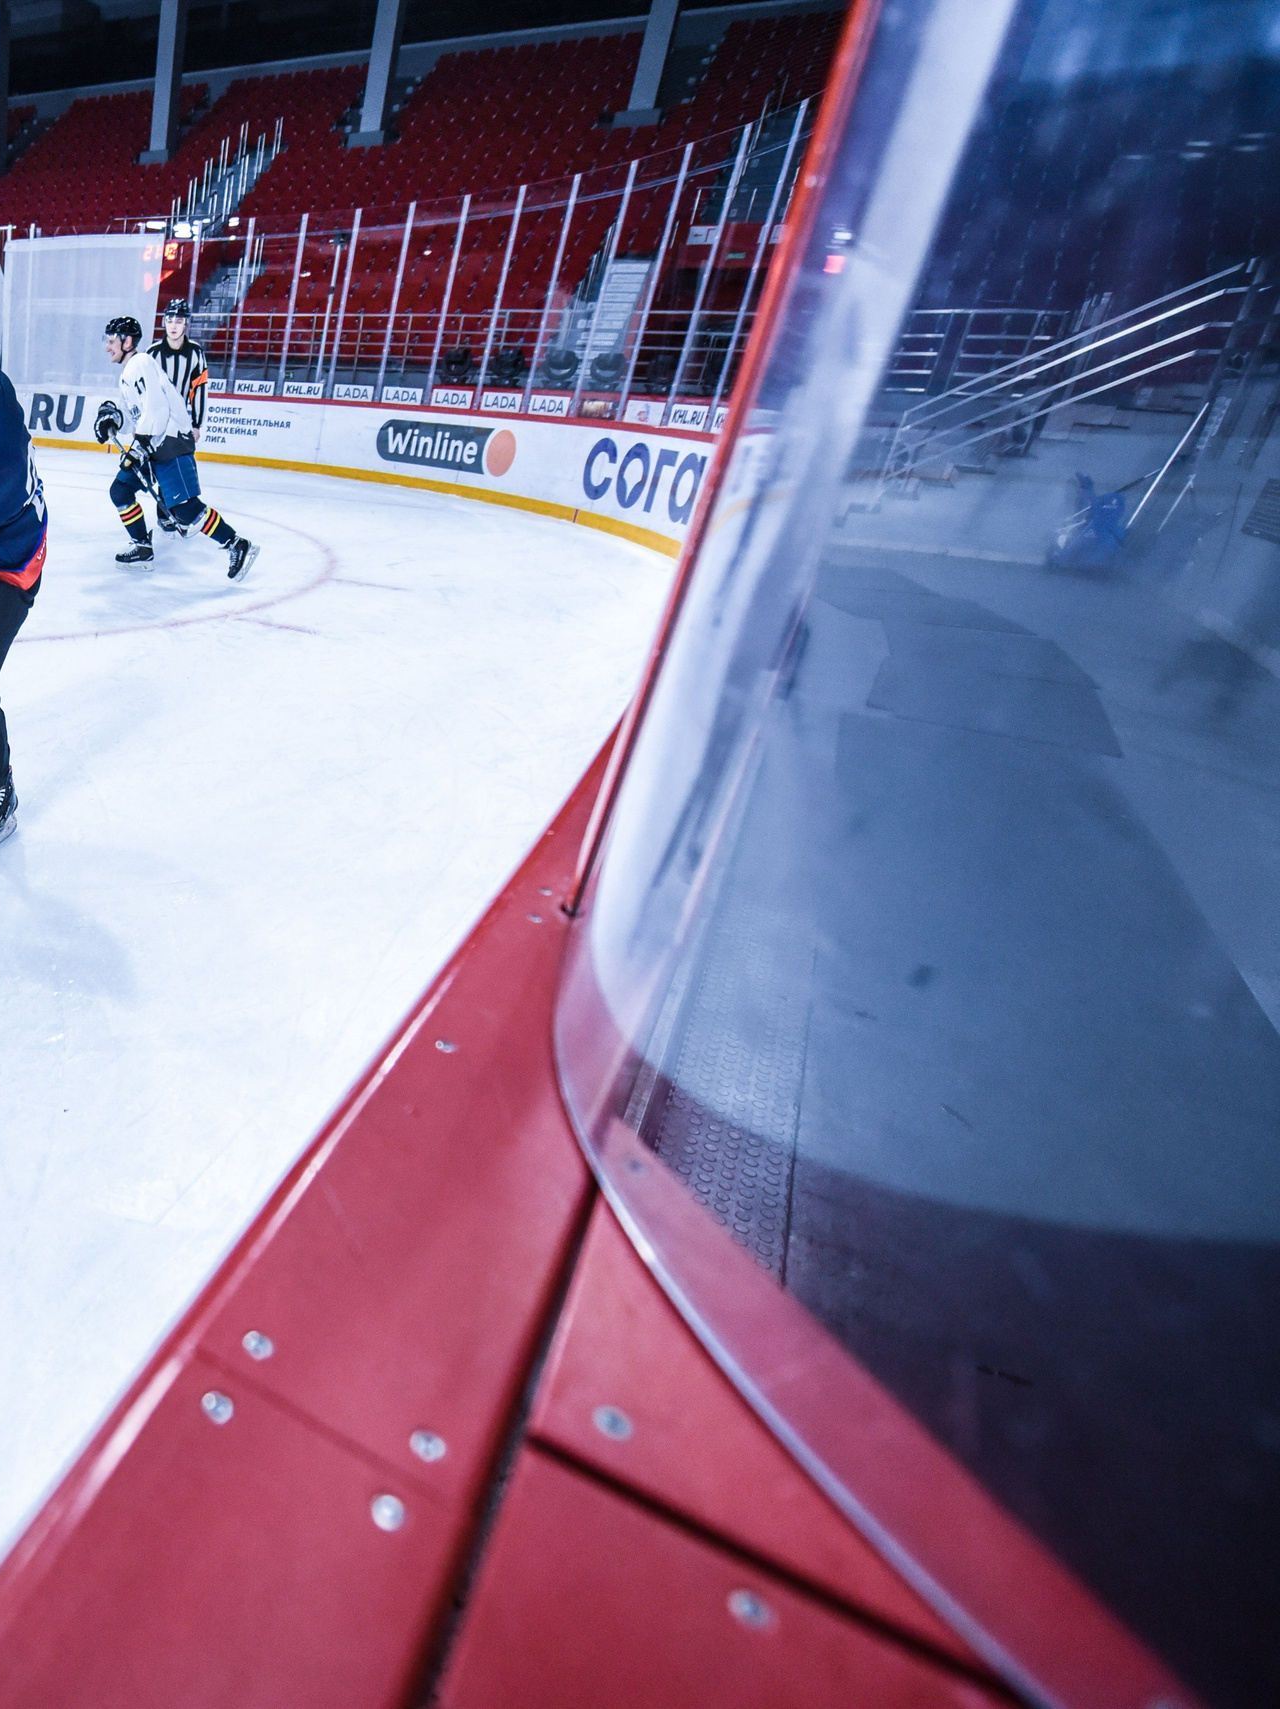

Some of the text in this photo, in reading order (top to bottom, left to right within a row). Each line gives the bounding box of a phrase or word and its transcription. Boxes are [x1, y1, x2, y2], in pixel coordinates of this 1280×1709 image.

[236, 382, 272, 394] KHL.RU
[285, 384, 320, 396] KHL.RU
[336, 386, 369, 400] LADA
[384, 388, 418, 402] LADA
[434, 391, 468, 406] LADA
[484, 395, 517, 410] LADA
[531, 397, 564, 414] LADA
[208, 406, 242, 415] ФОНБЕТ
[671, 408, 705, 426] KHL.RU
[207, 416, 291, 429] КОНТИНЕНТАЛЬНАЯ
[206, 425, 258, 437] ХОККЕЙНАЯ
[204, 435, 226, 444] ЛИГА
[387, 426, 478, 465] Winline
